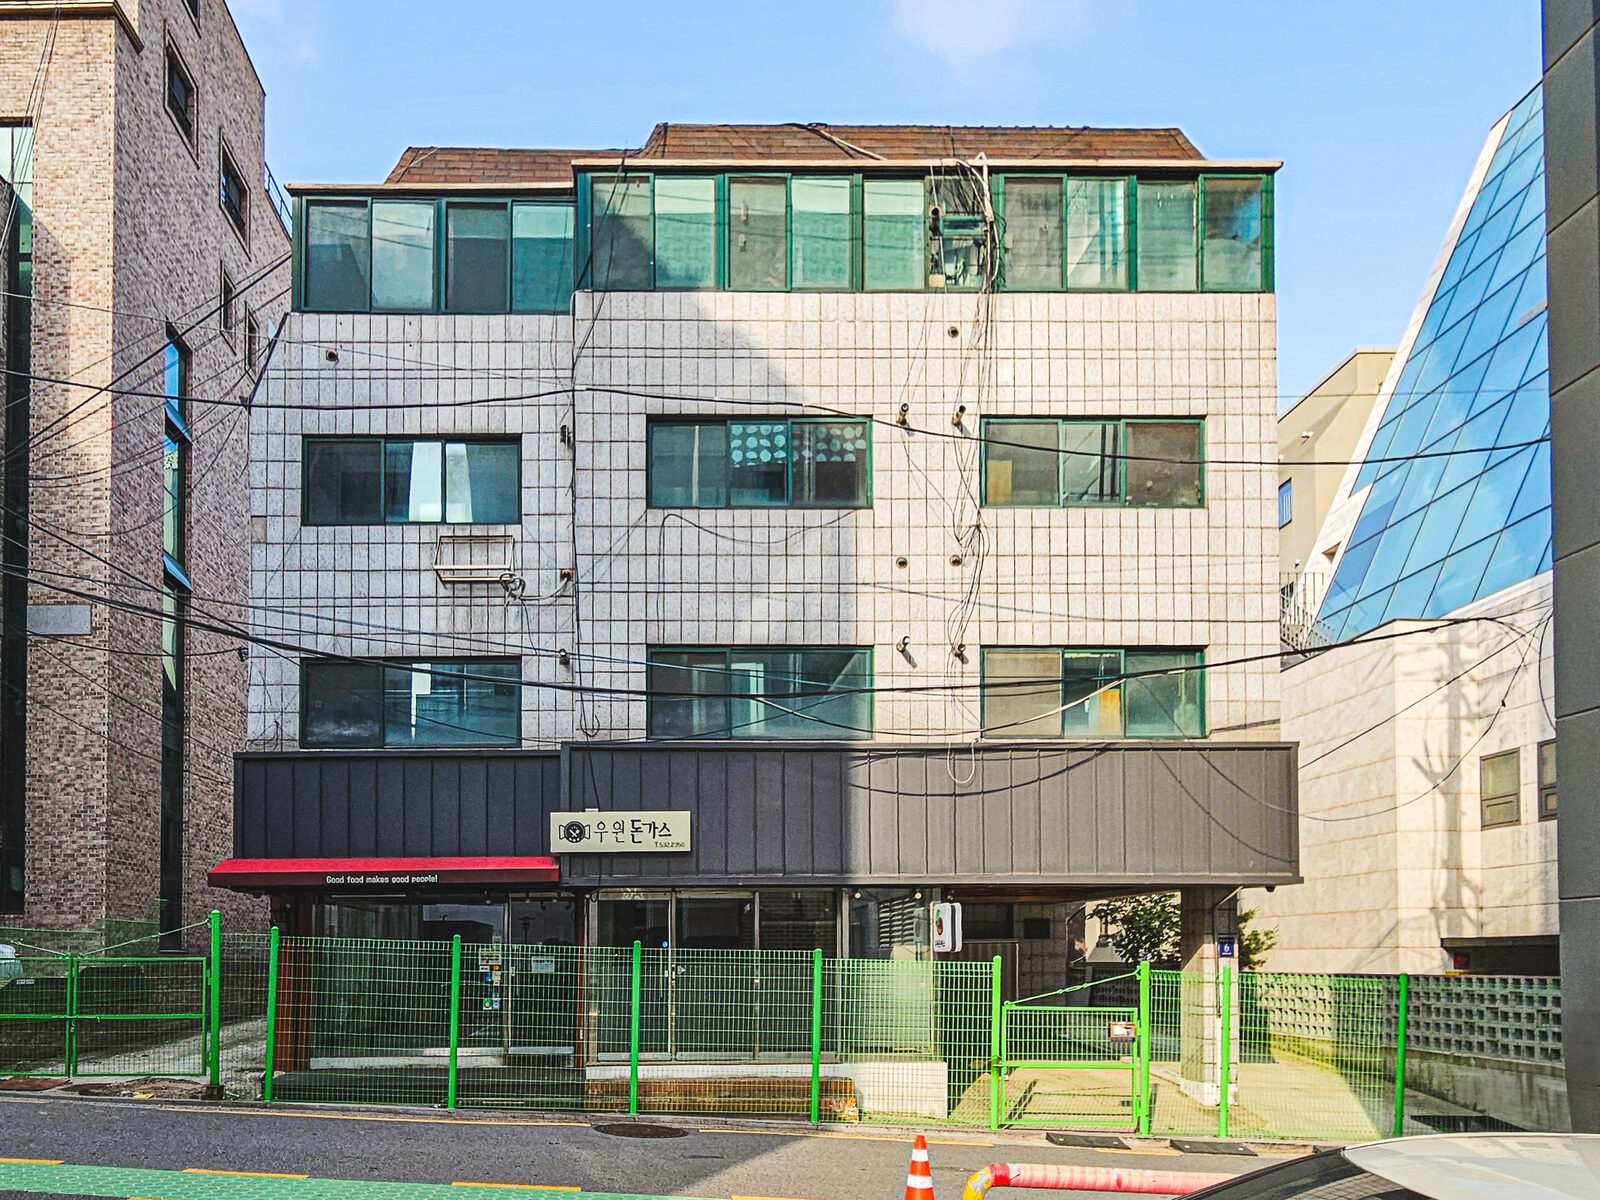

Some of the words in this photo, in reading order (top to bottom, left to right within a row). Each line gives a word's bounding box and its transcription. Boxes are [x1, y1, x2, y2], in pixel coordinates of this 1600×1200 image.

[326, 875, 345, 884] Good
[347, 875, 364, 884] food
[366, 875, 389, 884] makes
[391, 875, 410, 884] good
[411, 874, 438, 884] people!
[1224, 943, 1230, 952] 6
